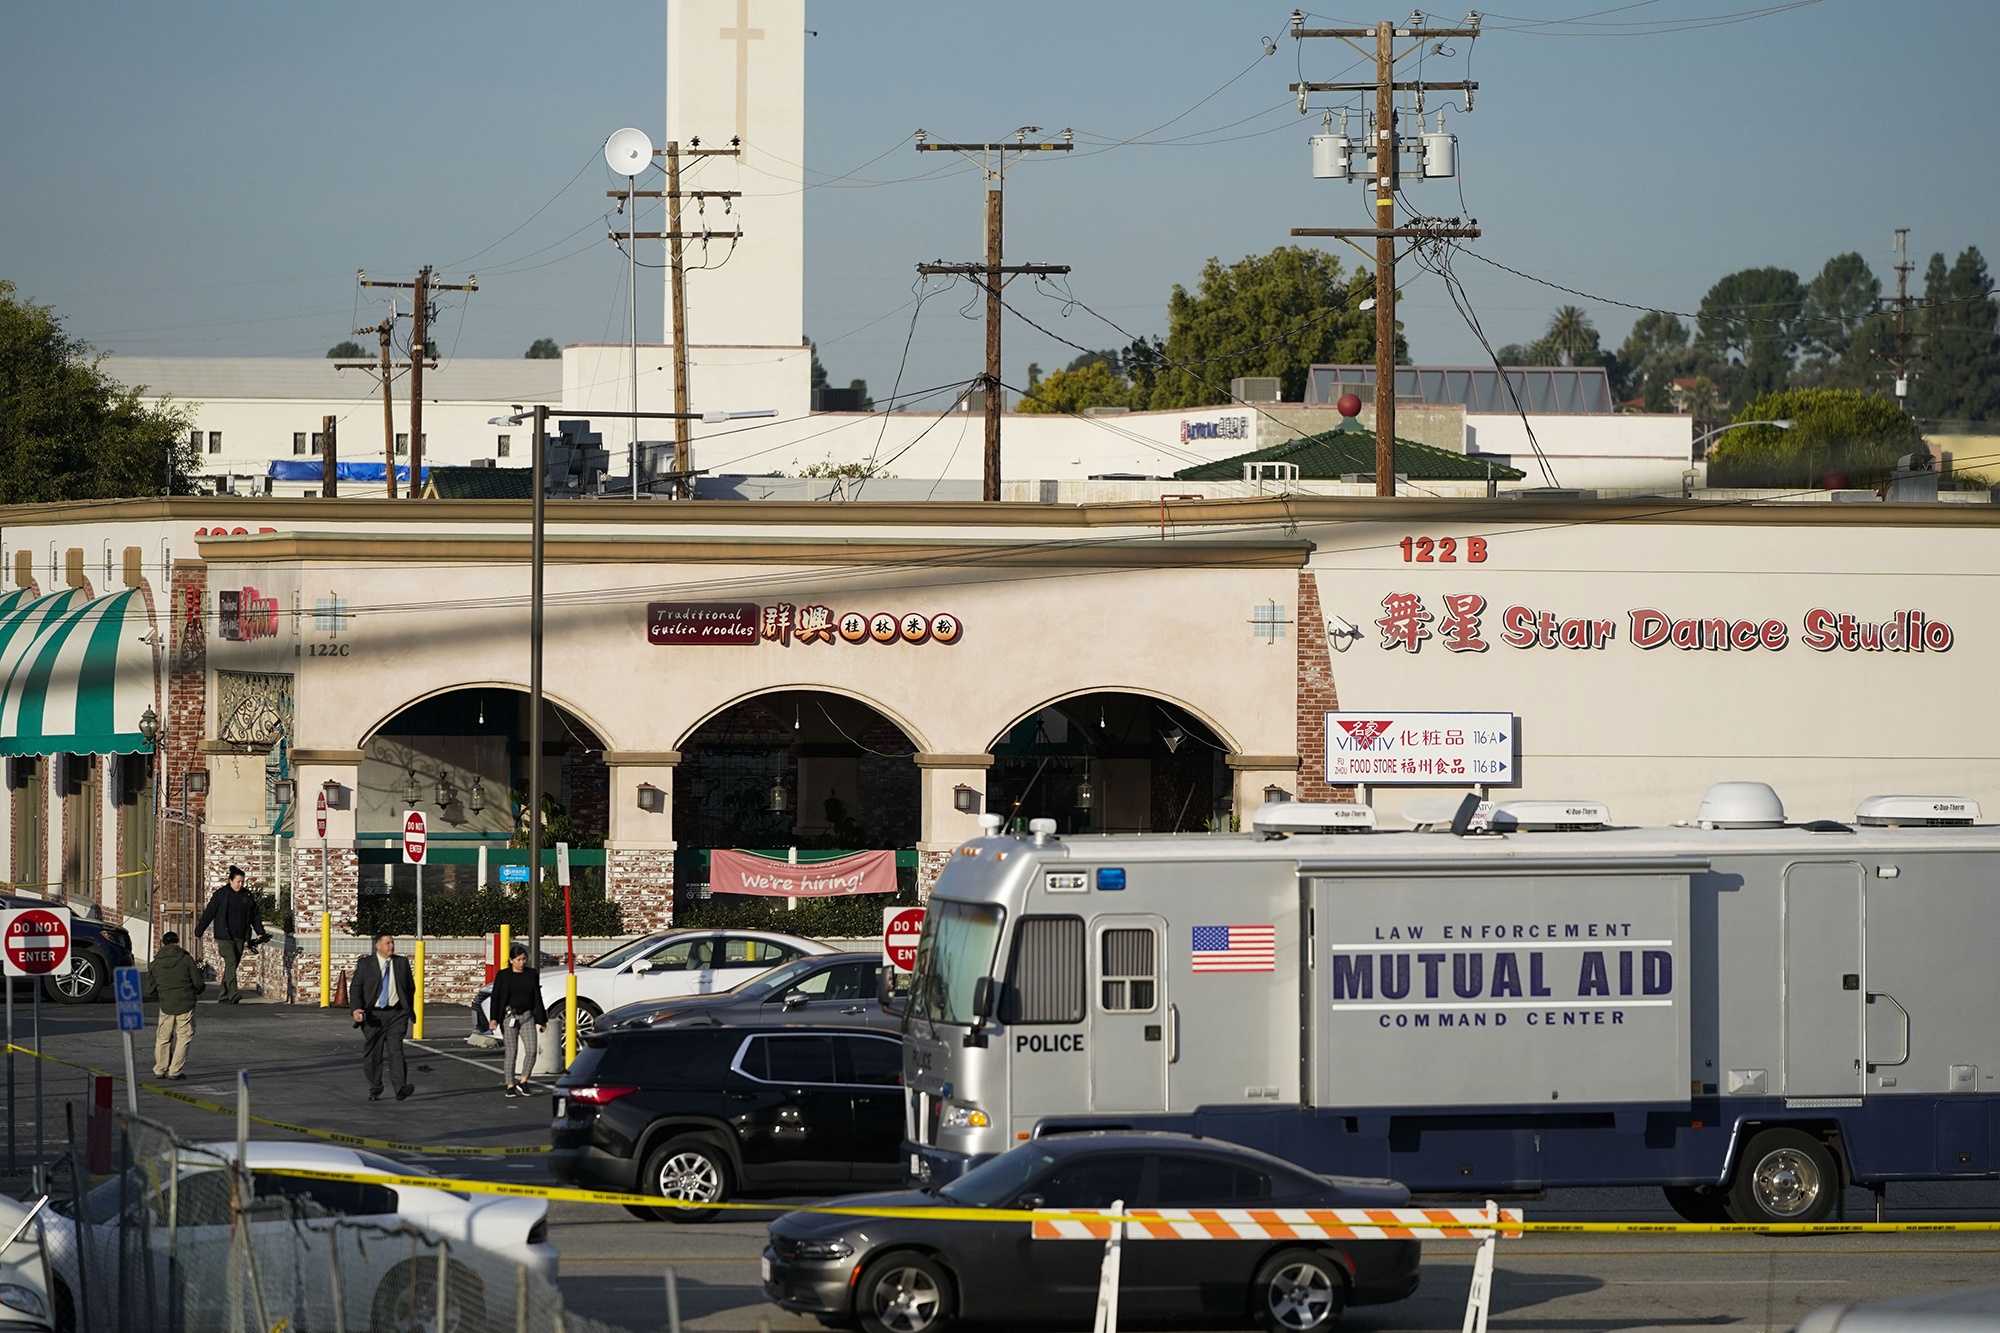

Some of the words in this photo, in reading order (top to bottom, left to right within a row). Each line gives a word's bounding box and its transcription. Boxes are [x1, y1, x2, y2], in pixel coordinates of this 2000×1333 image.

[1400, 536, 1457, 563] 122
[1467, 536, 1489, 563] B
[657, 608, 743, 621] Traditional
[1375, 591, 1490, 653] 舞星
[651, 623, 698, 636] Guilin
[701, 623, 755, 637] Noodles
[1501, 604, 1617, 651] Star
[1628, 607, 1790, 651] Dance
[1802, 607, 1955, 652] Studio
[309, 644, 350, 657] 122C
[1350, 720, 1381, 737] 名家
[1350, 759, 1371, 774] FOOD
[1373, 759, 1398, 774] STORE
[1401, 758, 1466, 775] 福州食品
[407, 821, 414, 830] DO
[409, 844, 422, 854] ENTER
[741, 871, 794, 891] We're
[800, 871, 865, 893] hiring!
[13, 922, 30, 934] DO
[35, 922, 60, 933] NOT
[893, 921, 910, 932] DO
[1375, 926, 1424, 940] LAW
[1443, 924, 1632, 939] ENFORCEMENT
[18, 950, 56, 962] ENTER
[1332, 952, 1551, 1000] MUTUAL
[1577, 951, 1673, 997] AID
[1379, 1012, 1507, 1028] COMMAND
[1526, 1011, 1625, 1026] CENTER
[1016, 1034, 1085, 1052] POLICE
